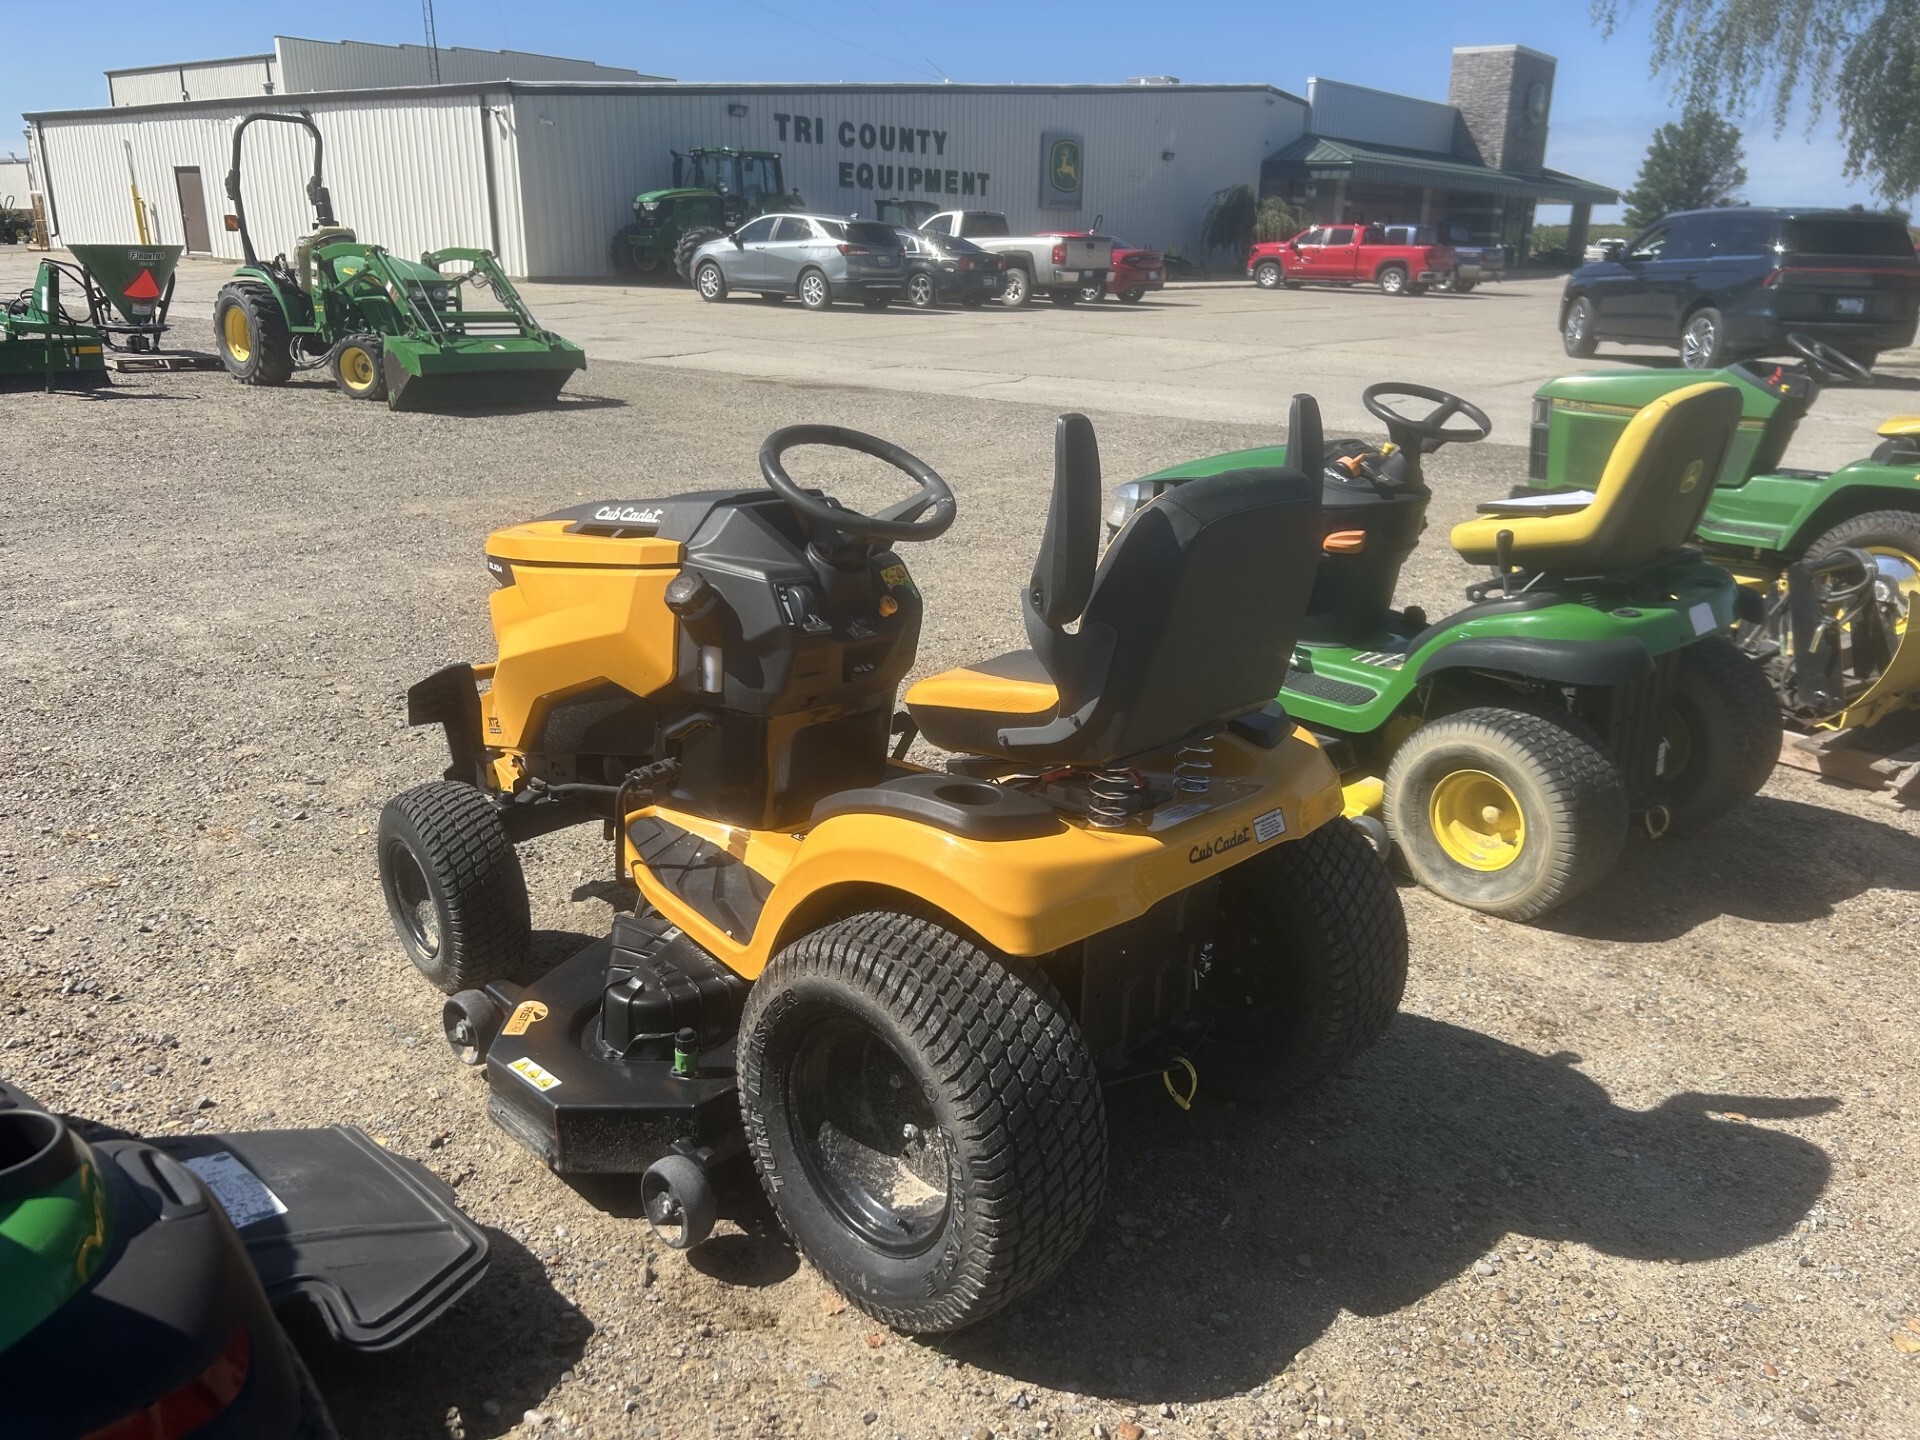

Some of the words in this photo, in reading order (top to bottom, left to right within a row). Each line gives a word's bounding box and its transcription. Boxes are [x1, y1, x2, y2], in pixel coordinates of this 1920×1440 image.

[774, 113, 823, 144] TRI
[838, 121, 947, 155] COUNTY
[838, 162, 990, 196] EQUIPMENT
[595, 506, 621, 520] Cub
[620, 507, 664, 523] Cadet
[1189, 842, 1213, 864] Cub
[1214, 826, 1250, 854] Cadet
[751, 1106, 785, 1193] TURF
[922, 1124, 966, 1297] CARLISLE
